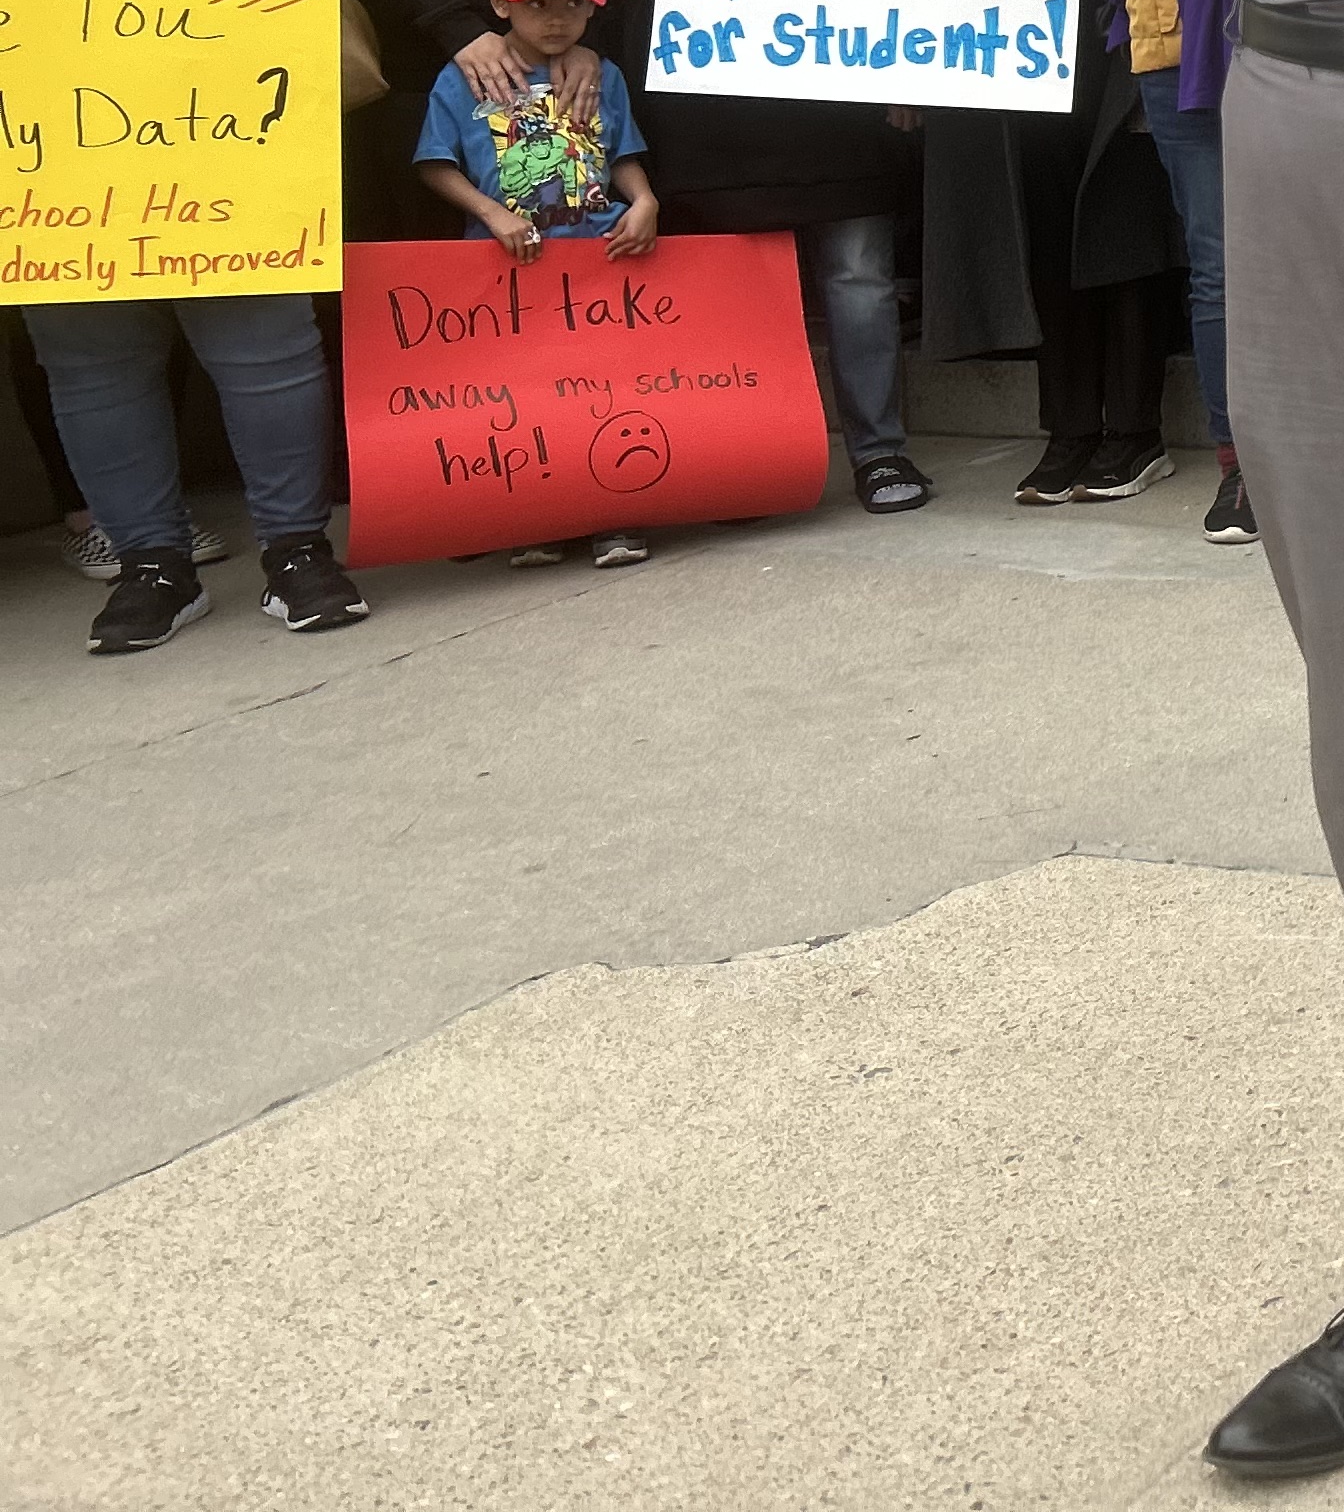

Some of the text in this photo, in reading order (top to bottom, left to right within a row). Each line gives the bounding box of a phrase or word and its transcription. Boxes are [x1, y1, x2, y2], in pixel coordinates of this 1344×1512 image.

[653, 10, 745, 76] for
[73, 66, 289, 148] Data?
[141, 182, 234, 224] Has
[128, 207, 326, 286] Improved!
[388, 266, 682, 350] Don't take
[389, 362, 759, 432] away my schools
[434, 425, 552, 494] help!
